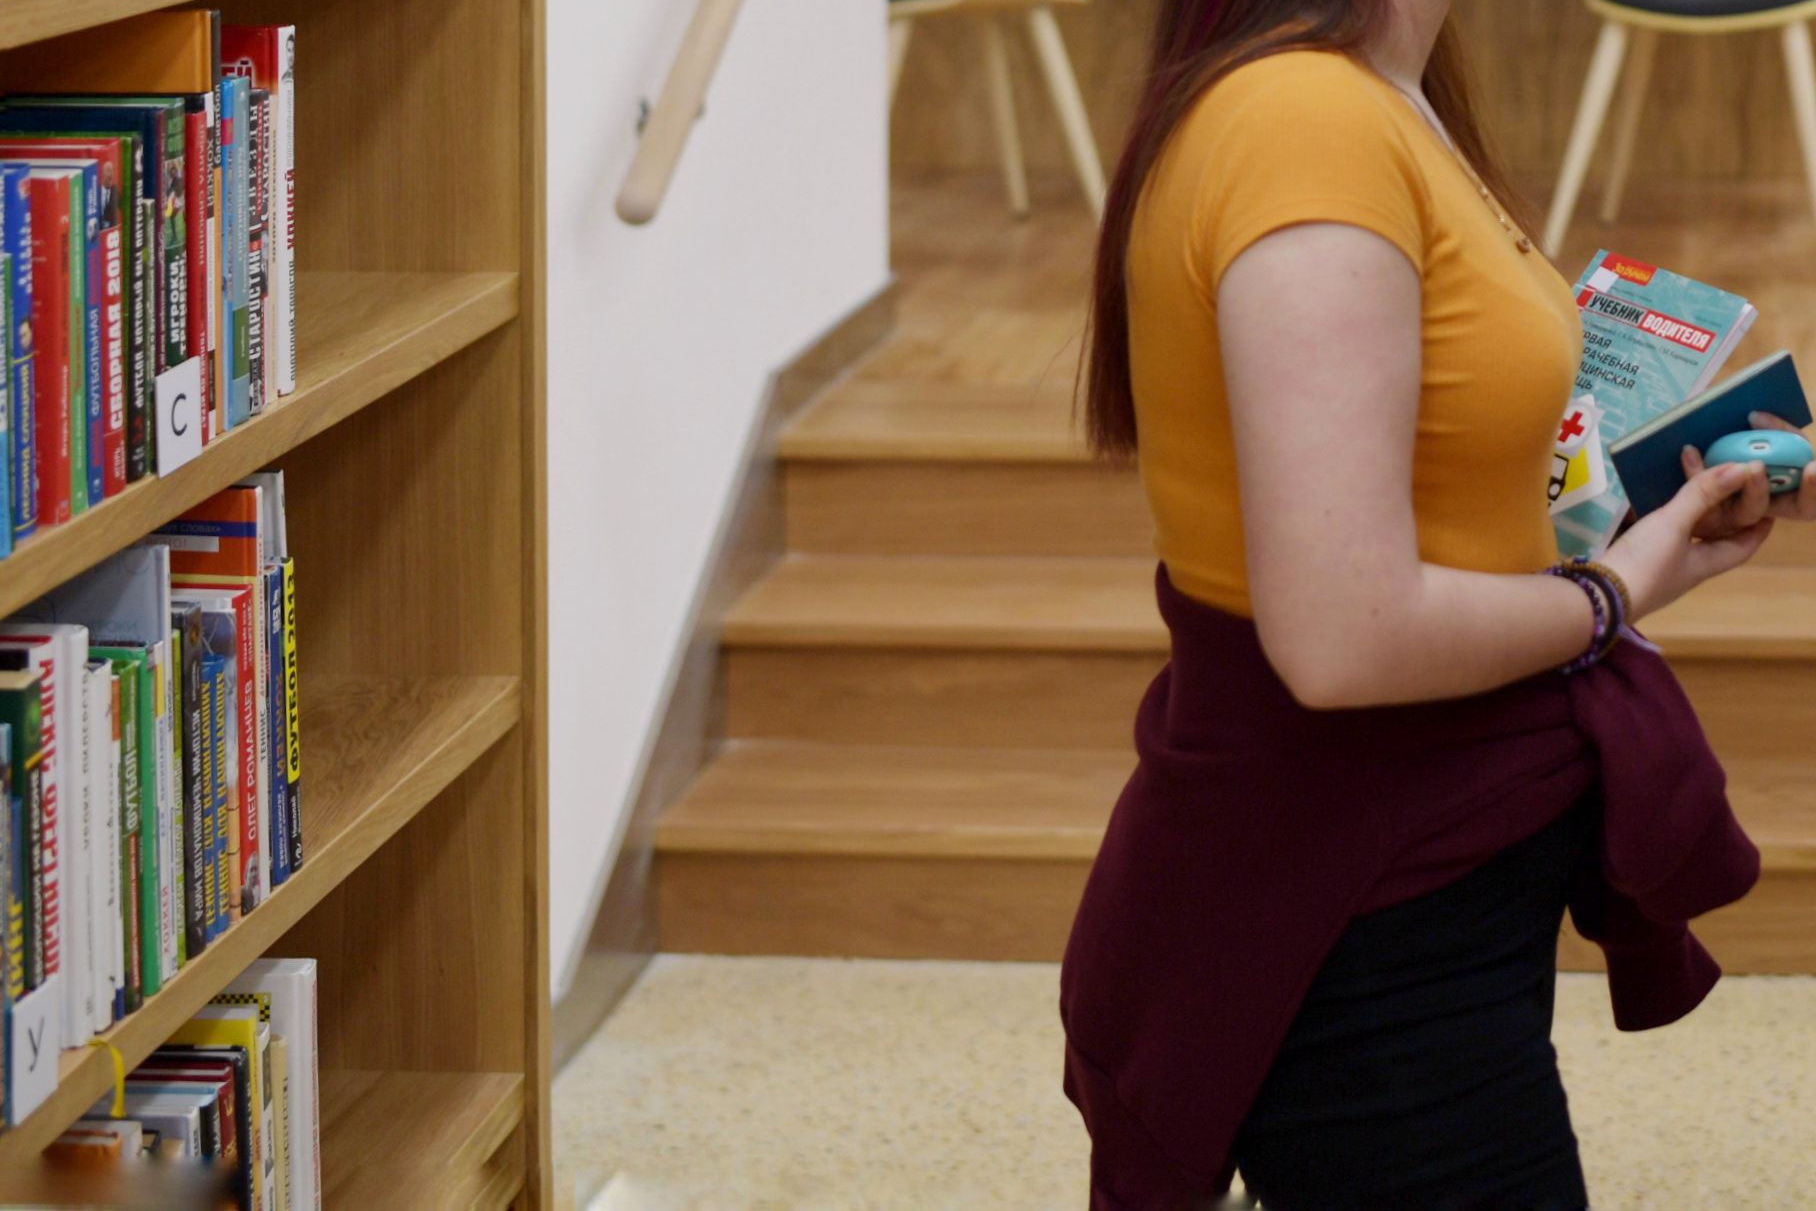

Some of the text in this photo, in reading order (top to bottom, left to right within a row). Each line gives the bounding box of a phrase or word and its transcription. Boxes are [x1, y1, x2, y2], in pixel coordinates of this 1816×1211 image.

[214, 83, 222, 165] баскетбол
[106, 229, 123, 431] СБОРНАЯ 2018
[169, 254, 180, 344] ИГРОКИ,
[248, 251, 261, 361] СТАРОСТИН
[1583, 331, 1613, 350] РВАЯ
[1589, 294, 1645, 325] УЧЕБНИК
[1641, 314, 1711, 350] ВОДИТЕЛЯ
[89, 308, 100, 417] ФУТБОЛЬНАЯ
[1582, 346, 1640, 376] РАЧЕБНАЯ
[170, 392, 189, 437] С
[286, 574, 299, 772] ФУТБОЛ 2013
[244, 679, 257, 841] ОЛЕГ РОМАНЦЕВ
[276, 674, 286, 779] ХОККЕЙ
[31, 767, 40, 840] ГАЗОНЕ
[124, 748, 139, 831] ФУТБОЛ
[201, 680, 216, 926] ТЕННИС ДЛЯ НАЧИНАЮЩИХ
[215, 671, 230, 917] ТЕННИС ДЛЯ НАЧИНАЮЩИХ
[32, 843, 42, 871] НА
[26, 1017, 46, 1072] У
